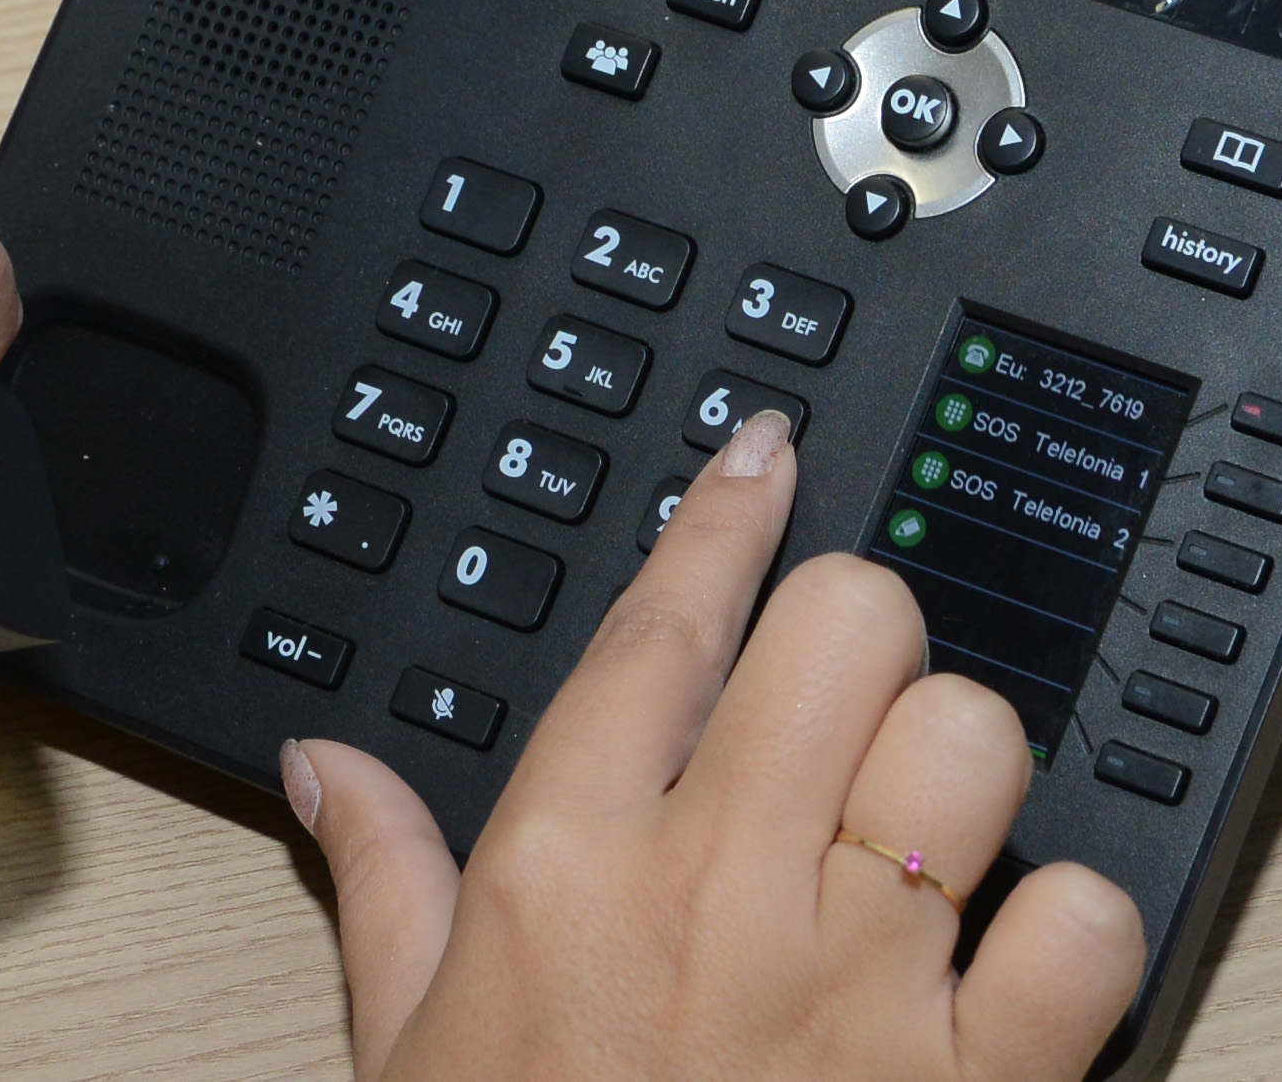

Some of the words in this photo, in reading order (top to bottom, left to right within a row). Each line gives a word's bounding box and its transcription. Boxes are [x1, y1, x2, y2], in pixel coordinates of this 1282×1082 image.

[890, 89, 941, 124] OK
[442, 174, 465, 213] 1
[584, 226, 621, 267] 2
[624, 260, 665, 285] ABC
[1160, 225, 1243, 274] history
[389, 281, 424, 319] 4
[428, 312, 463, 336] GHI
[742, 278, 775, 319] 3
[782, 312, 819, 337] DEF
[541, 331, 578, 370] 5
[584, 366, 614, 390] JKL
[996, 353, 1027, 380] Eu:
[1039, 369, 1144, 420] 3212_7619
[345, 382, 382, 420] 7
[378, 413, 425, 443] PQRS
[700, 387, 730, 426] 6
[499, 439, 533, 478] 8
[539, 470, 576, 497] TUV
[973, 411, 1021, 443] SOS
[1034, 431, 1125, 481] Telefonia
[1138, 469, 1149, 489] 1
[950, 469, 998, 501] SOS
[1012, 489, 1102, 540] Telefonia
[1113, 528, 1130, 550] 2
[456, 545, 488, 585] 0
